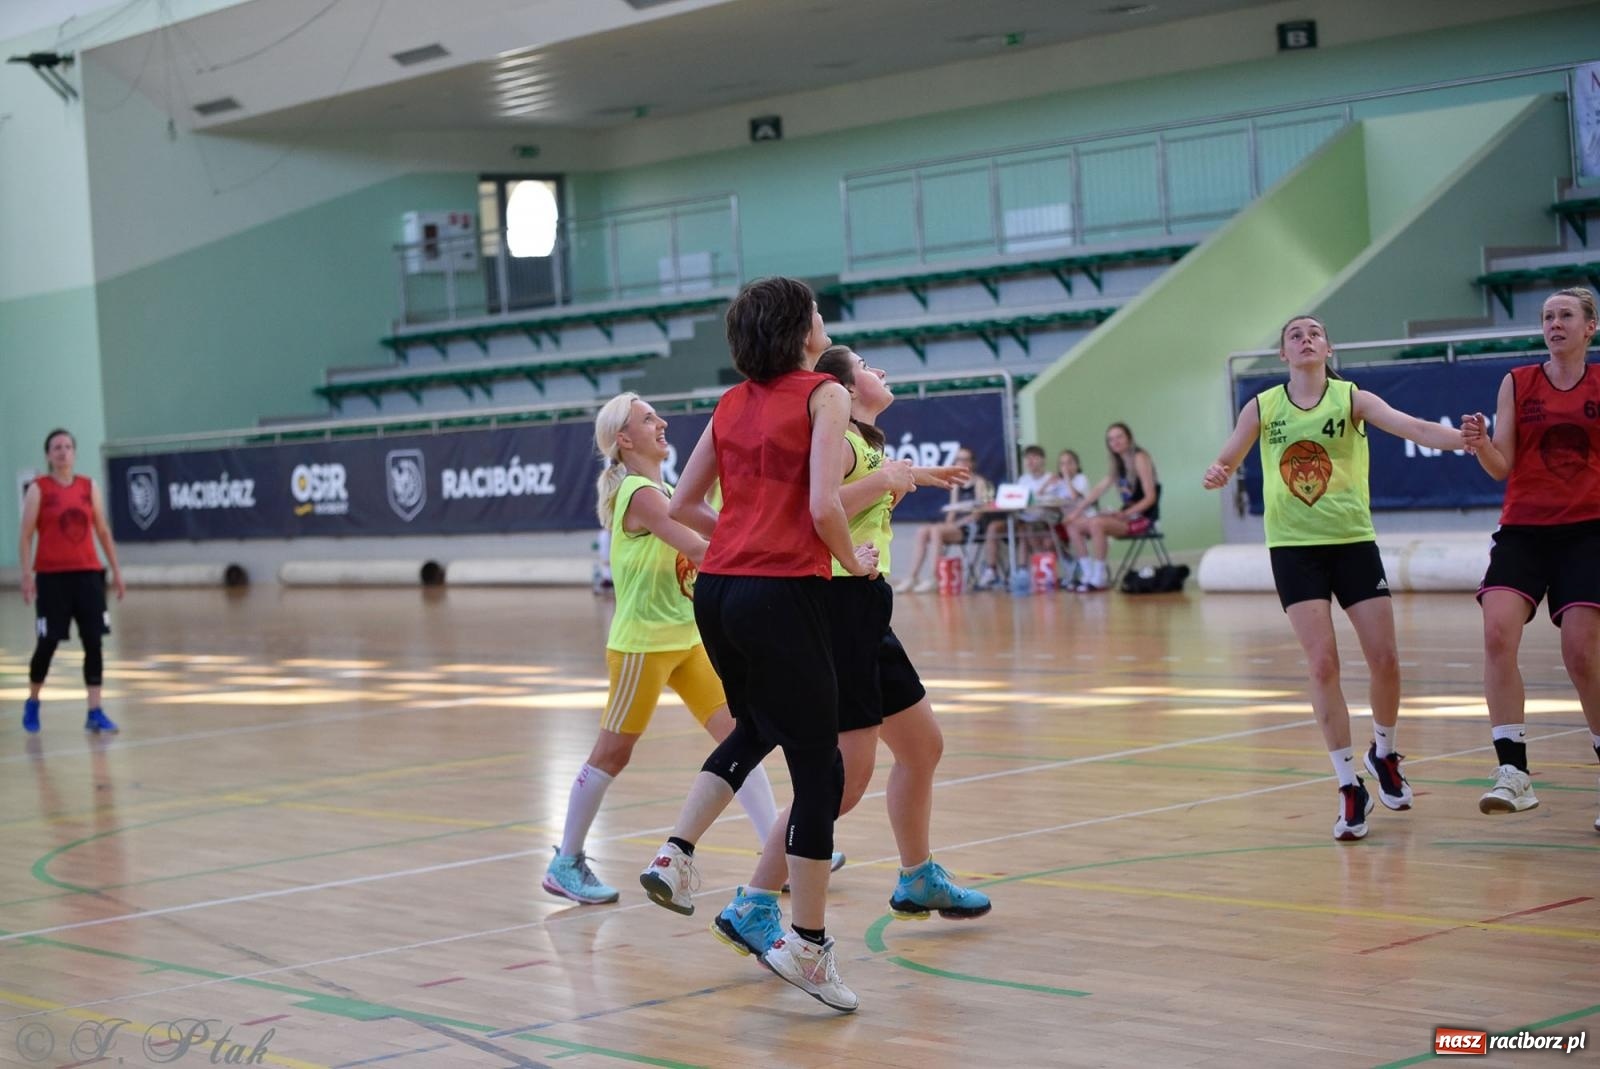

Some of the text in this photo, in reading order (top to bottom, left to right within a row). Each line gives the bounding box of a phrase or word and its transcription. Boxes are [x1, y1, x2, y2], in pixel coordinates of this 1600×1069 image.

[1287, 31, 1308, 47] B
[1584, 400, 1600, 418] 6
[1322, 418, 1346, 438] 41
[442, 456, 555, 499] RACIBÓRZ
[168, 472, 256, 511] RACIBÓRZ
